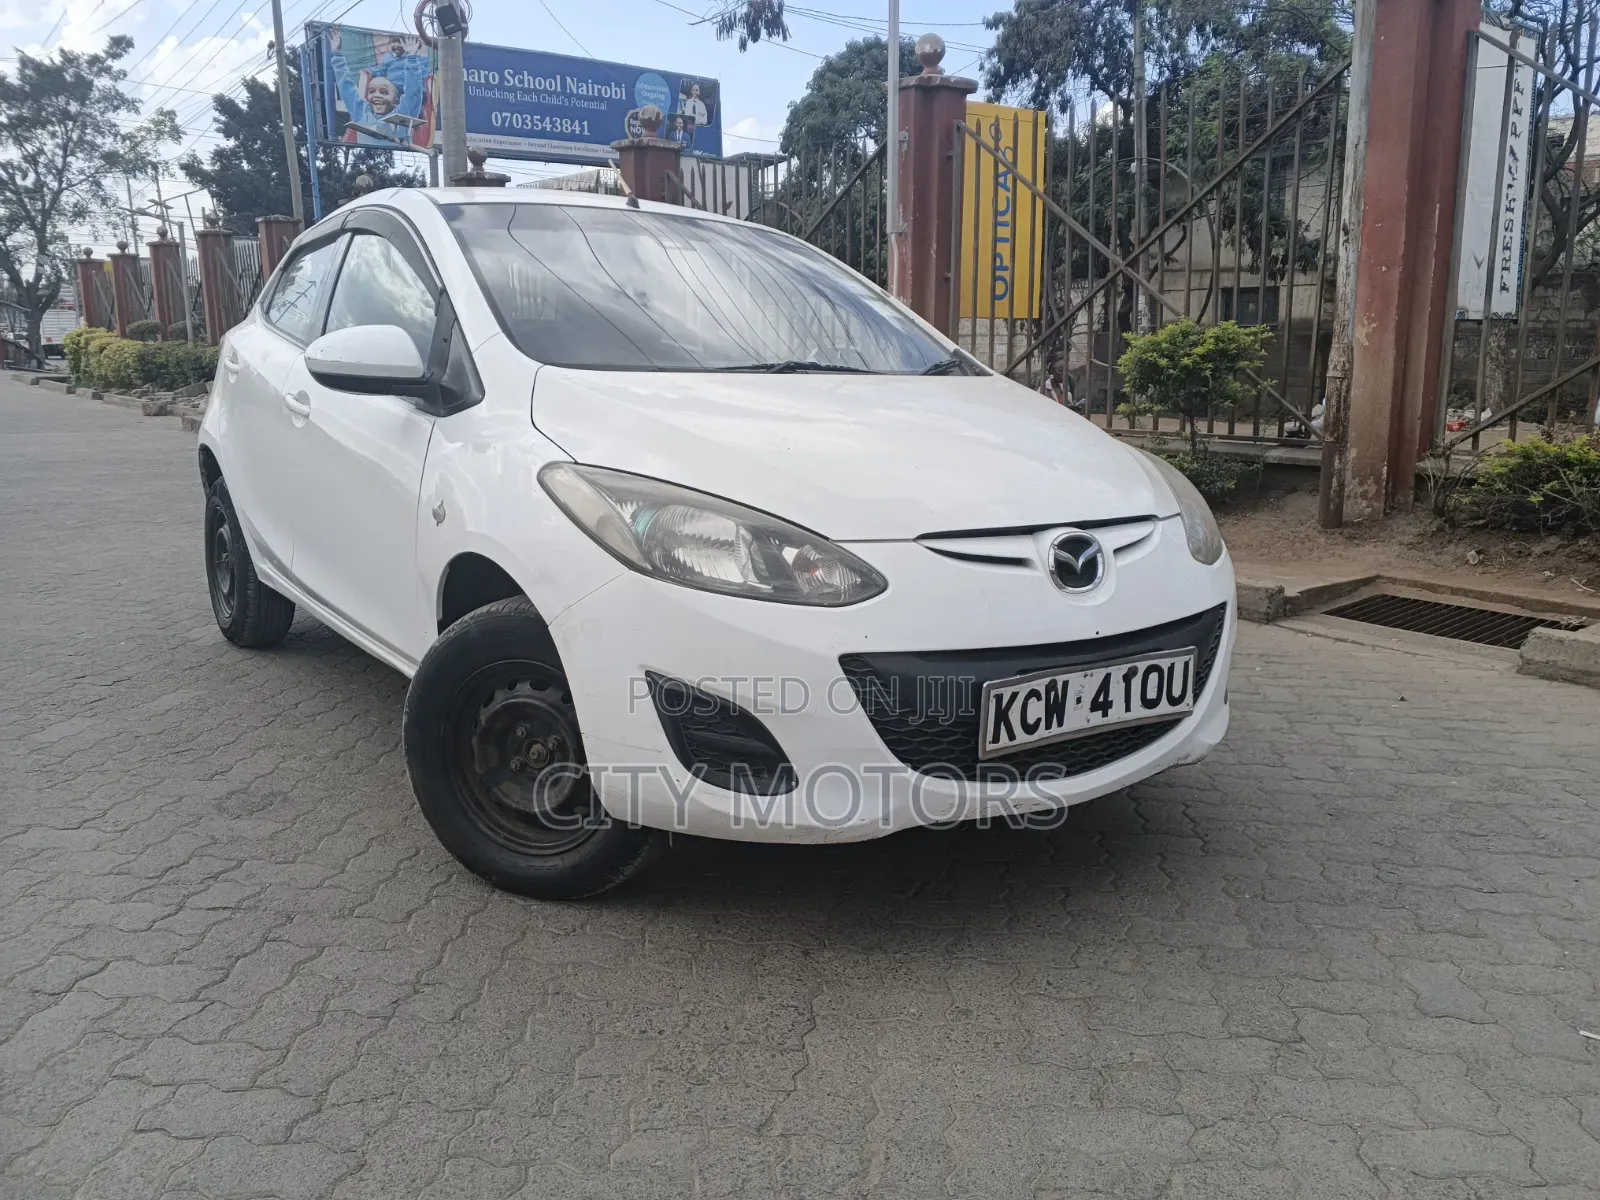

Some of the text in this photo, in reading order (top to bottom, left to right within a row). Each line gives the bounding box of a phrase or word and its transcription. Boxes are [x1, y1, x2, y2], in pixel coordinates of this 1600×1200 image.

[468, 85, 608, 110] Unlocking Each Child's Potential
[504, 69, 561, 92] School
[565, 76, 627, 100] Nairobi
[491, 111, 591, 135] 0703543841
[992, 168, 1014, 301] OPTICA
[992, 657, 1191, 745] KCW 410U
